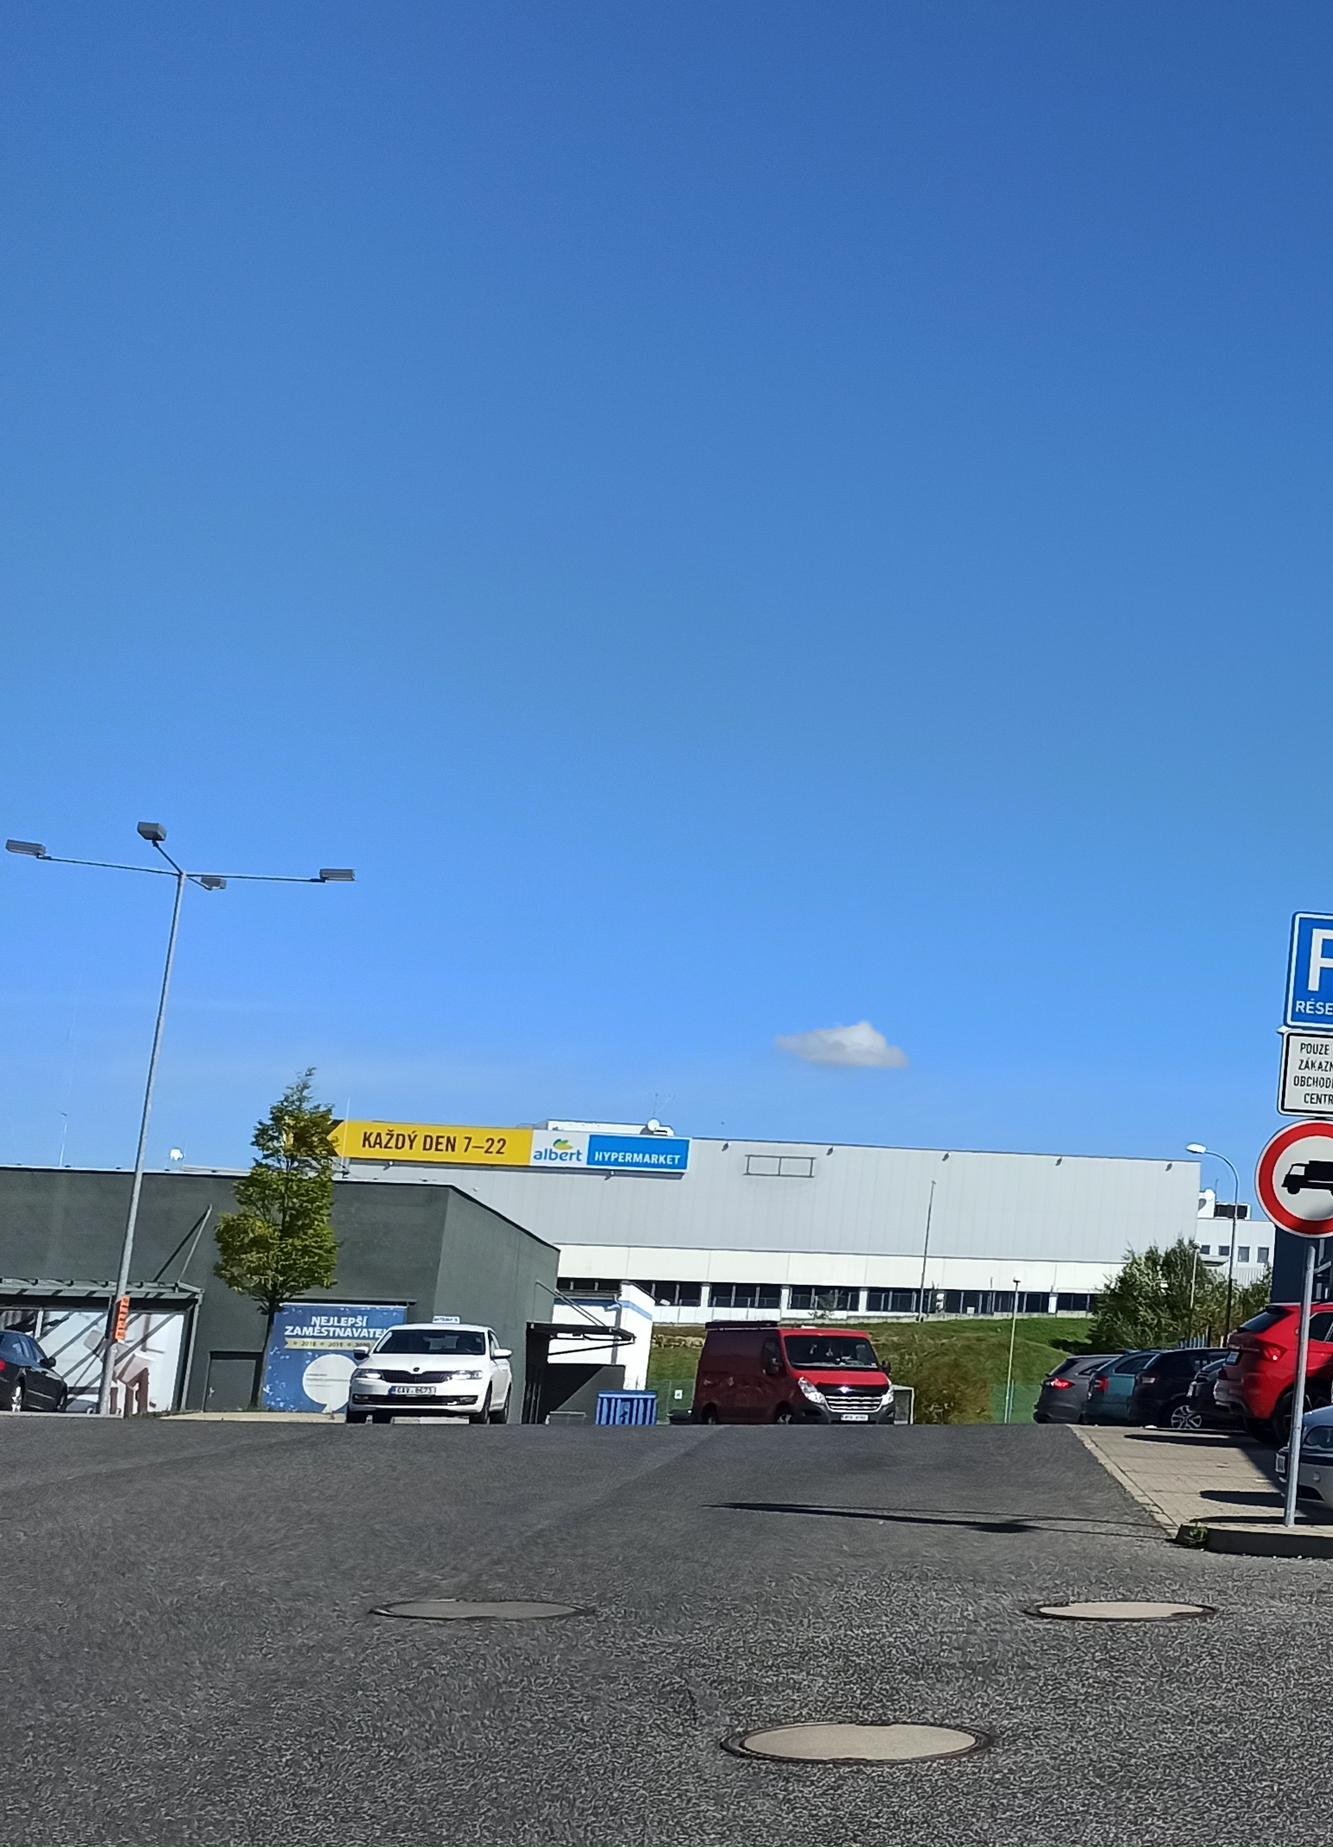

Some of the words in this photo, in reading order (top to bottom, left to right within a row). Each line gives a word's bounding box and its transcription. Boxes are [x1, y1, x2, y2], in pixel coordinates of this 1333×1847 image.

[1300, 1042, 1330, 1056] POUZE
[361, 1129, 419, 1151] KAŽDÝ
[422, 1134, 457, 1153] DEN
[533, 1144, 583, 1164] albert
[594, 1150, 683, 1165] HYPERMARKET
[310, 1315, 368, 1327] NEJLEPŠÍ
